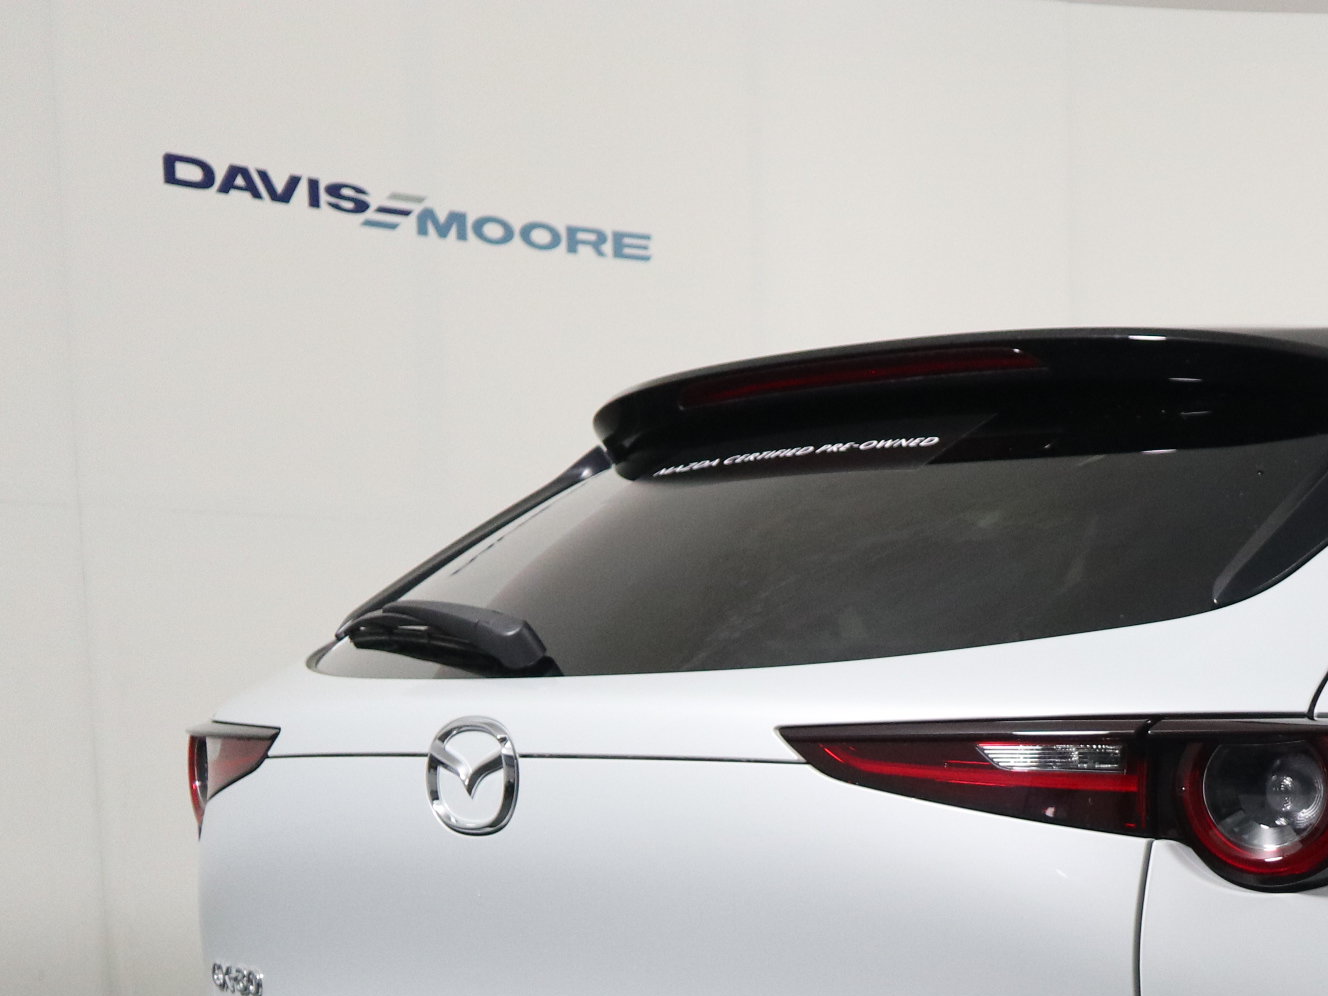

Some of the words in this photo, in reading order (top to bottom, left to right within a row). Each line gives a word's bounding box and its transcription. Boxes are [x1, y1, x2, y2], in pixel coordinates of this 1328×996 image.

[162, 152, 371, 216] DAVIS
[416, 207, 652, 263] MOORE
[653, 458, 720, 477] MAZDA
[723, 446, 814, 465] CERTIFIED
[815, 436, 939, 454] PRE-OWNED
